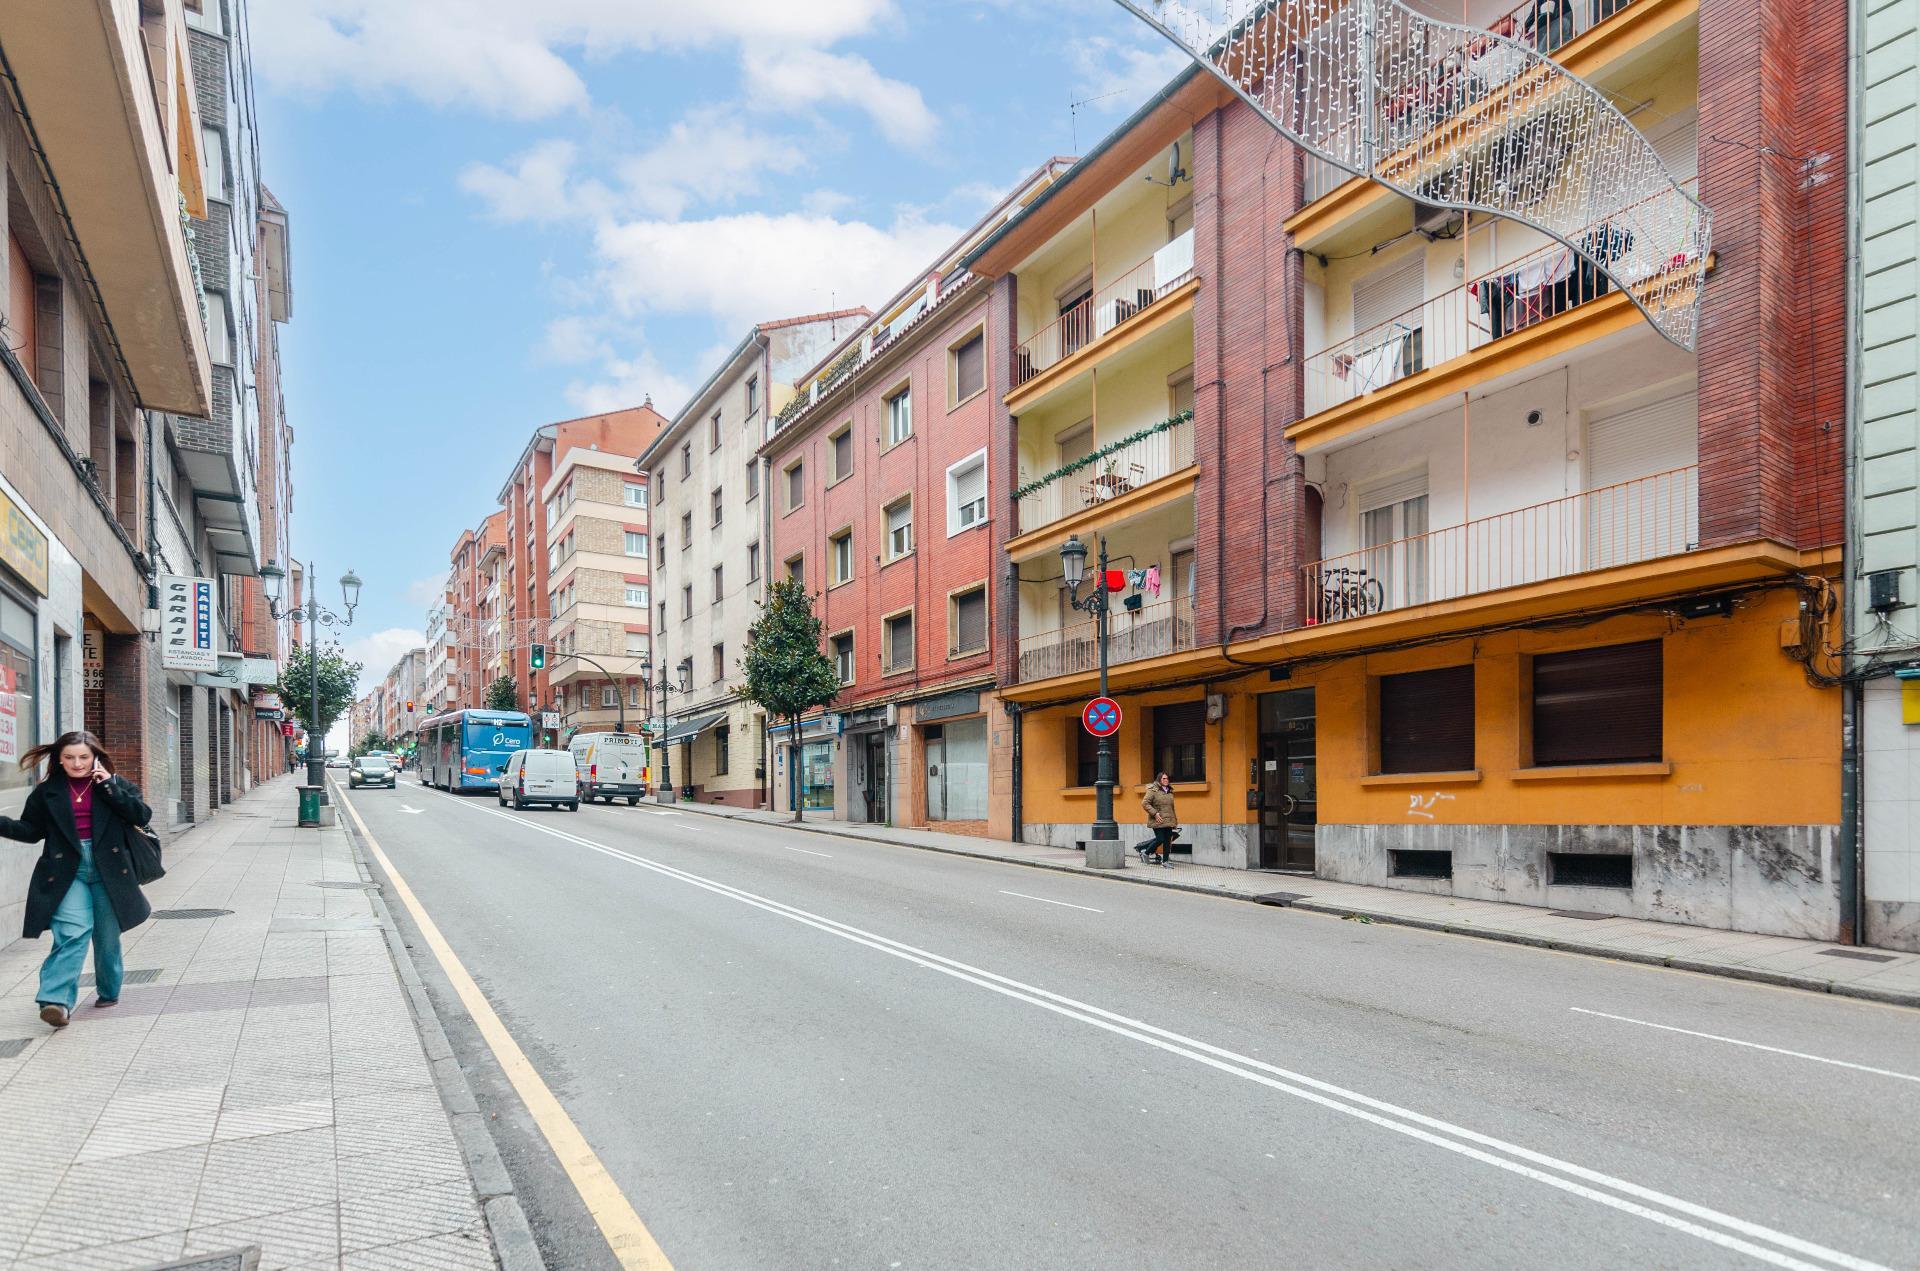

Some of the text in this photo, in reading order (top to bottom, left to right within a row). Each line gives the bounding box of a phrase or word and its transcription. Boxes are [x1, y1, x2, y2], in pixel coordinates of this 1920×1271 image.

[169, 583, 187, 646] GARAJE
[198, 585, 210, 648] CARRETE
[168, 649, 205, 657] ESTANCIAS
[92, 669, 105, 678] 66
[92, 679, 105, 688] 20
